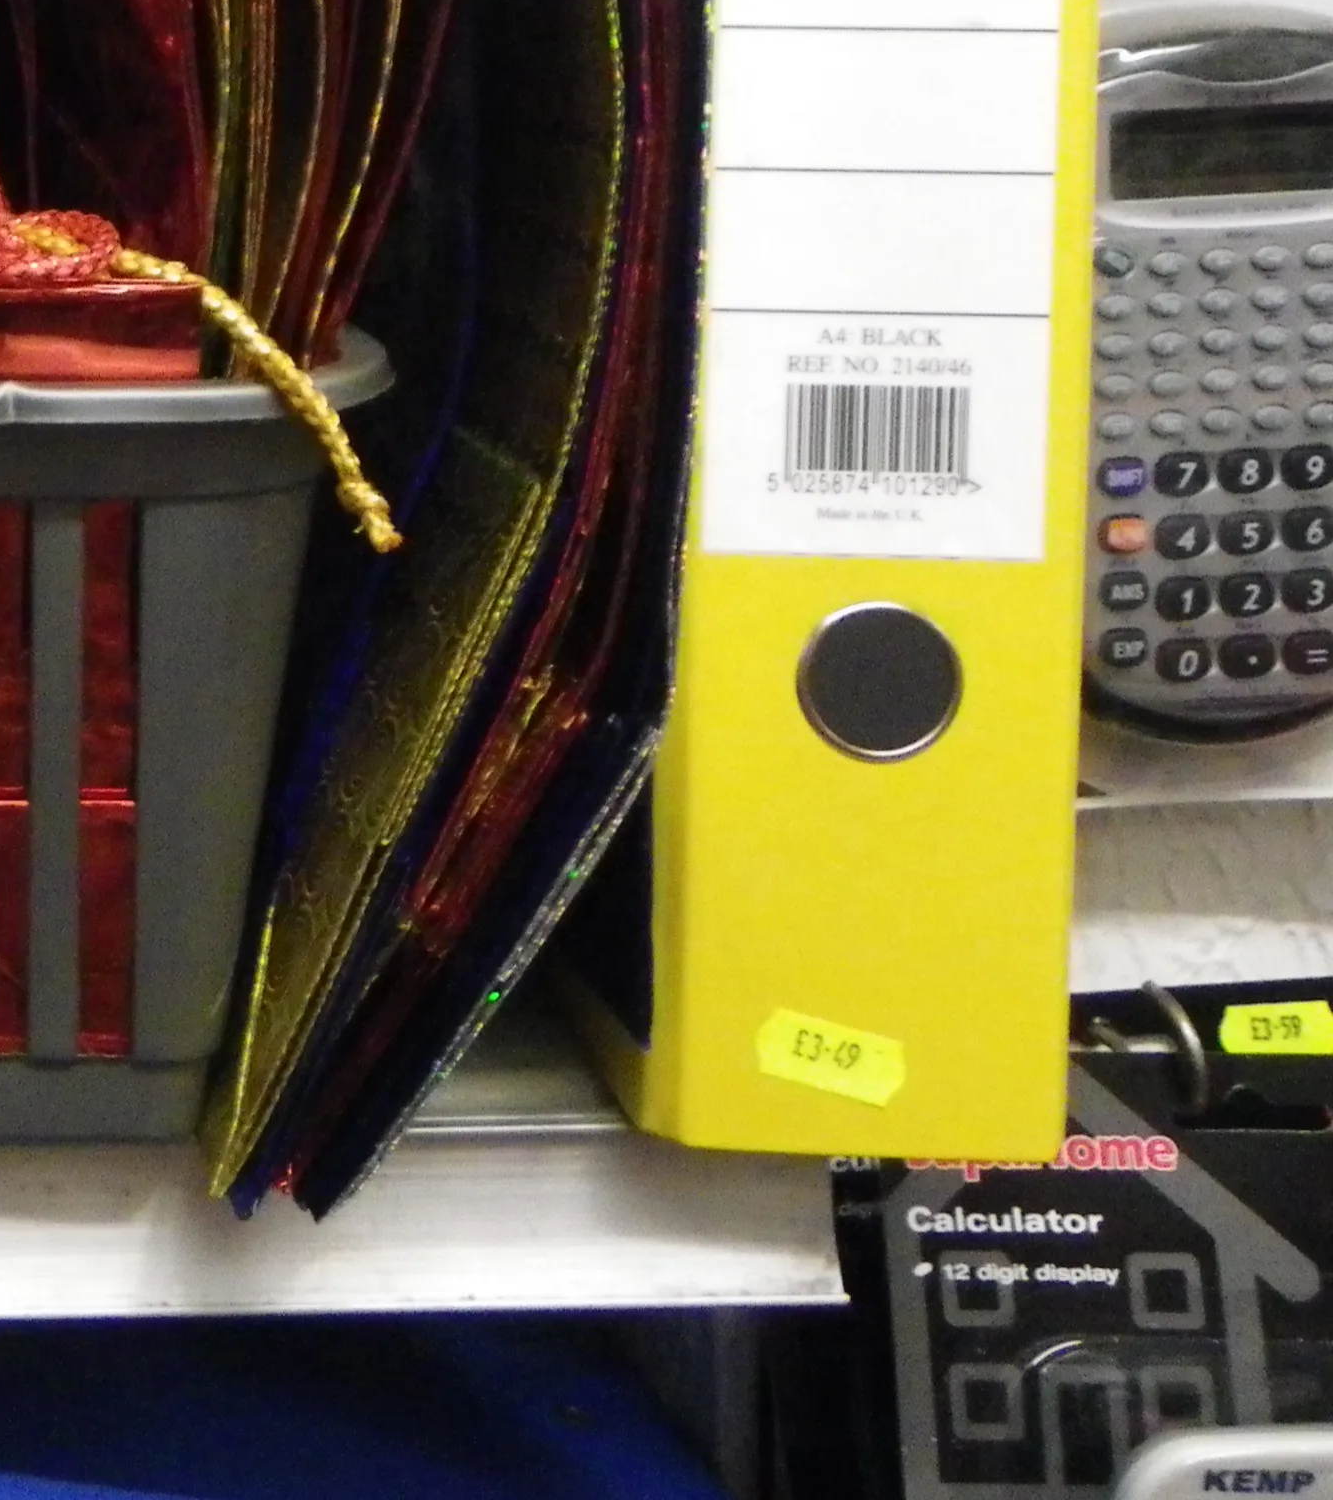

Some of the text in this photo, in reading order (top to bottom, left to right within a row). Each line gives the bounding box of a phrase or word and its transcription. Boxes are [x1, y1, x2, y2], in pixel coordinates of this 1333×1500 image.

[861, 328, 943, 348] BLACK
[1178, 462, 1197, 489] 7
[1240, 458, 1259, 486] 8
[1305, 454, 1326, 481] 9
[1177, 518, 1325, 552] 4 5 6
[1182, 587, 1195, 614] 1
[1241, 583, 1262, 610] 2
[1306, 579, 1327, 605] 3
[1178, 650, 1199, 677] 0
[906, 1205, 1104, 1234] Calculator
[943, 1262, 1121, 1287] 12 digit display
